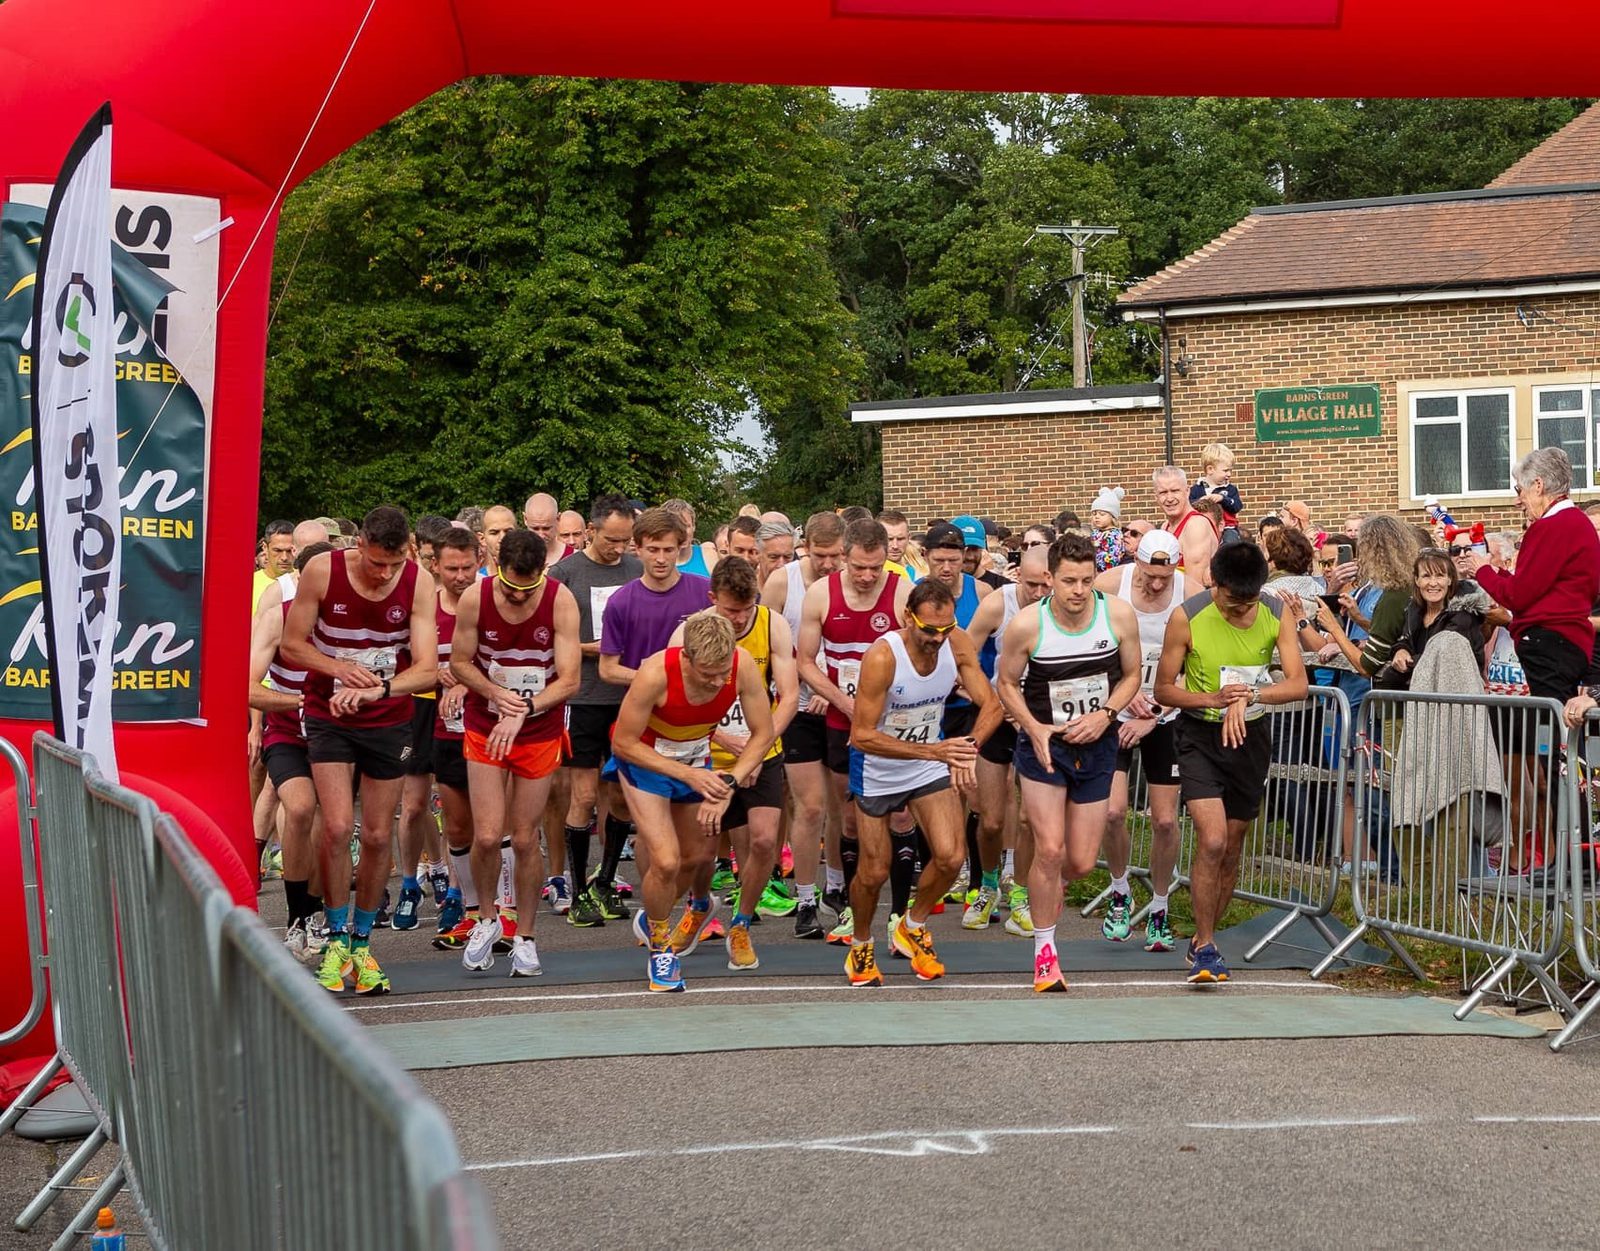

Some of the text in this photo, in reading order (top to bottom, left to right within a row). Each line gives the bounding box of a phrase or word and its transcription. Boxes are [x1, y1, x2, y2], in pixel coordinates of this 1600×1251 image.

[115, 360, 182, 384] GREE
[1285, 391, 1349, 403] BARNS GREEN
[1261, 403, 1375, 423] VILLAGE HALL
[123, 516, 194, 540] REEN
[891, 695, 945, 710] HORSHAM
[1062, 696, 1100, 722] 918
[894, 725, 930, 744] 764
